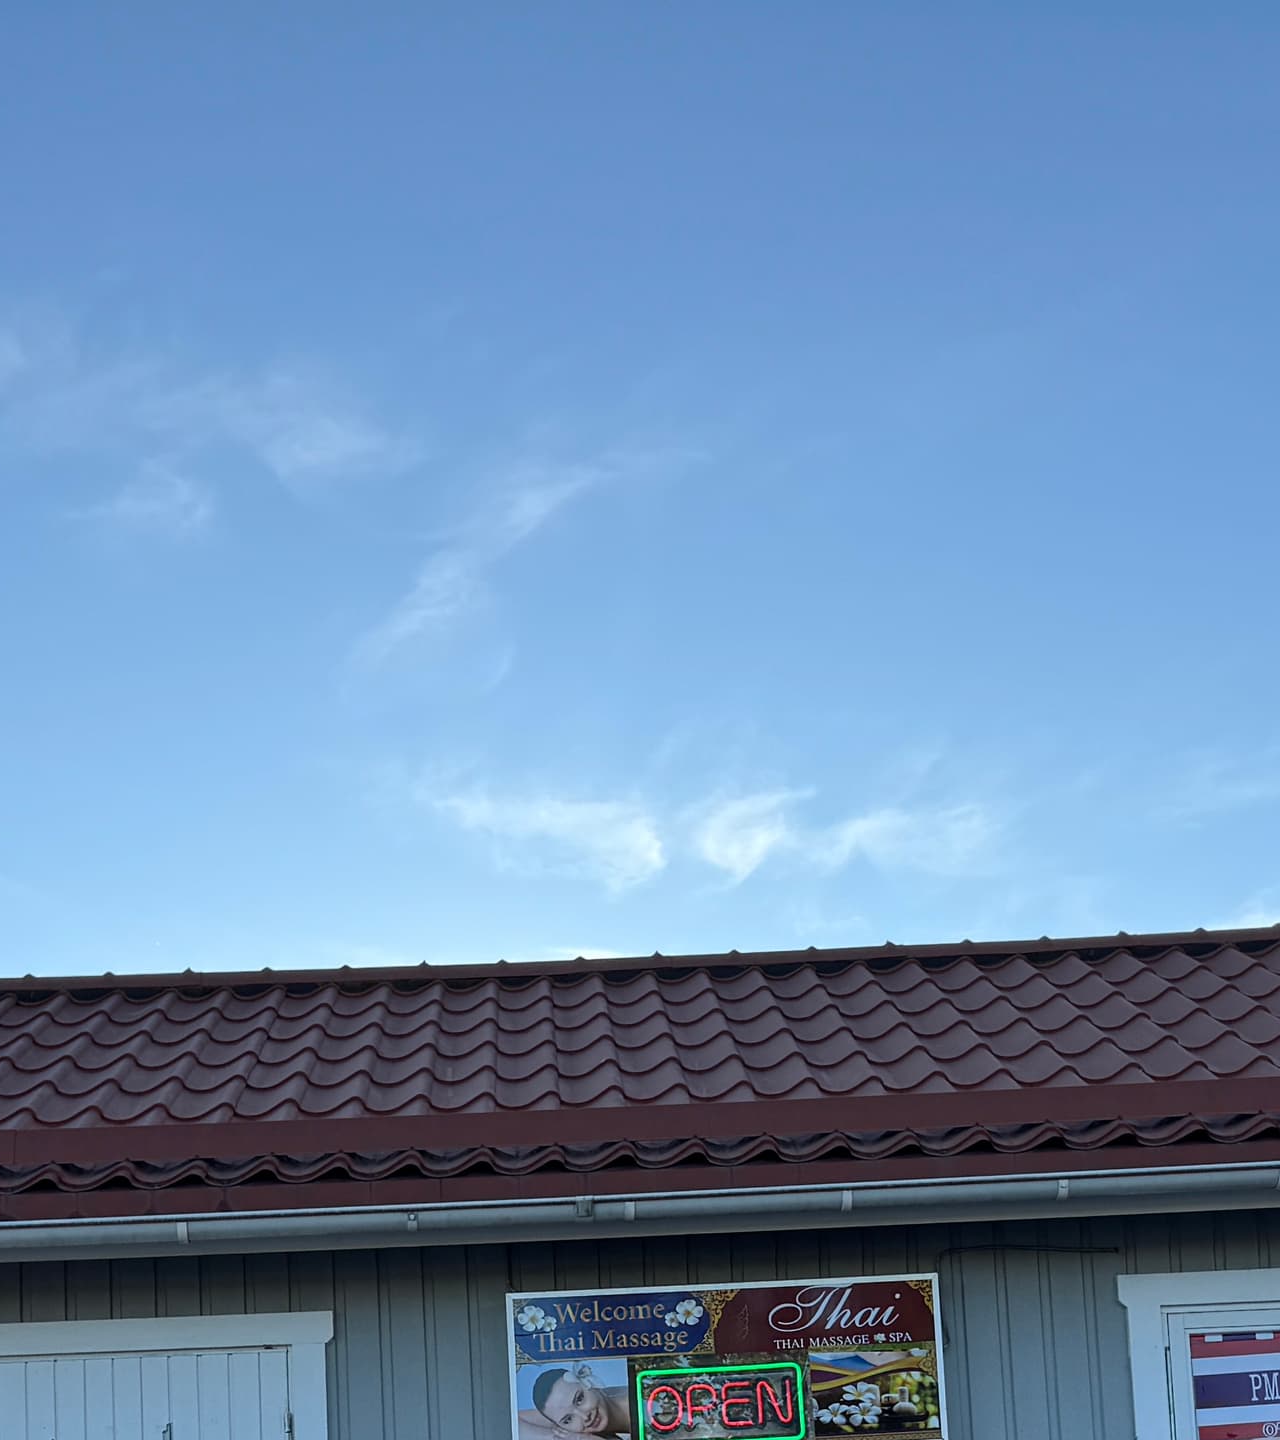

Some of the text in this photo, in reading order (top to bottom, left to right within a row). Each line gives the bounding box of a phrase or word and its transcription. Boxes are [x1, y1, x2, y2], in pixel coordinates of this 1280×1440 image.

[553, 1300, 665, 1324] Welcome
[768, 1285, 902, 1333] Thai
[533, 1329, 689, 1353] Thai Massage
[773, 1331, 912, 1350] THAI MASSAGE SPA
[647, 1379, 794, 1431] OPEN
